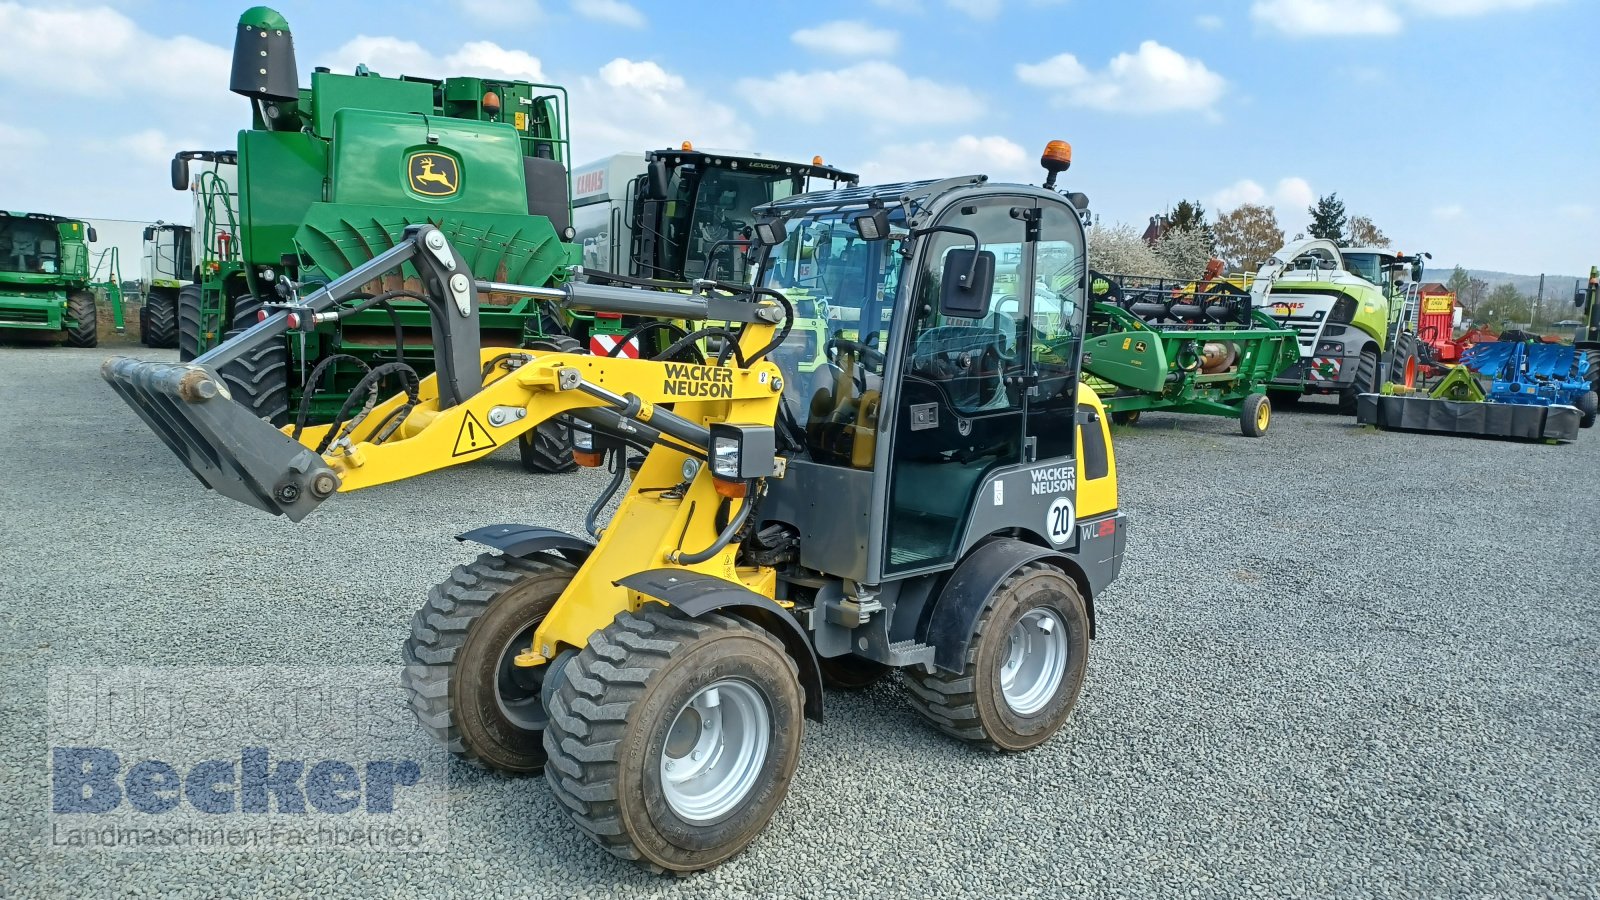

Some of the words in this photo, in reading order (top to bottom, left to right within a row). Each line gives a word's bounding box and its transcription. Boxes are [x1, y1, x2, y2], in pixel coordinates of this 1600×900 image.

[749, 162, 780, 170] LEXION
[576, 171, 604, 194] CLAAS
[664, 363, 733, 383] WACKER
[663, 379, 733, 398] NEUSON
[1030, 466, 1075, 482] WACKER
[1031, 479, 1075, 495] NEUSON
[1053, 505, 1069, 536] 20
